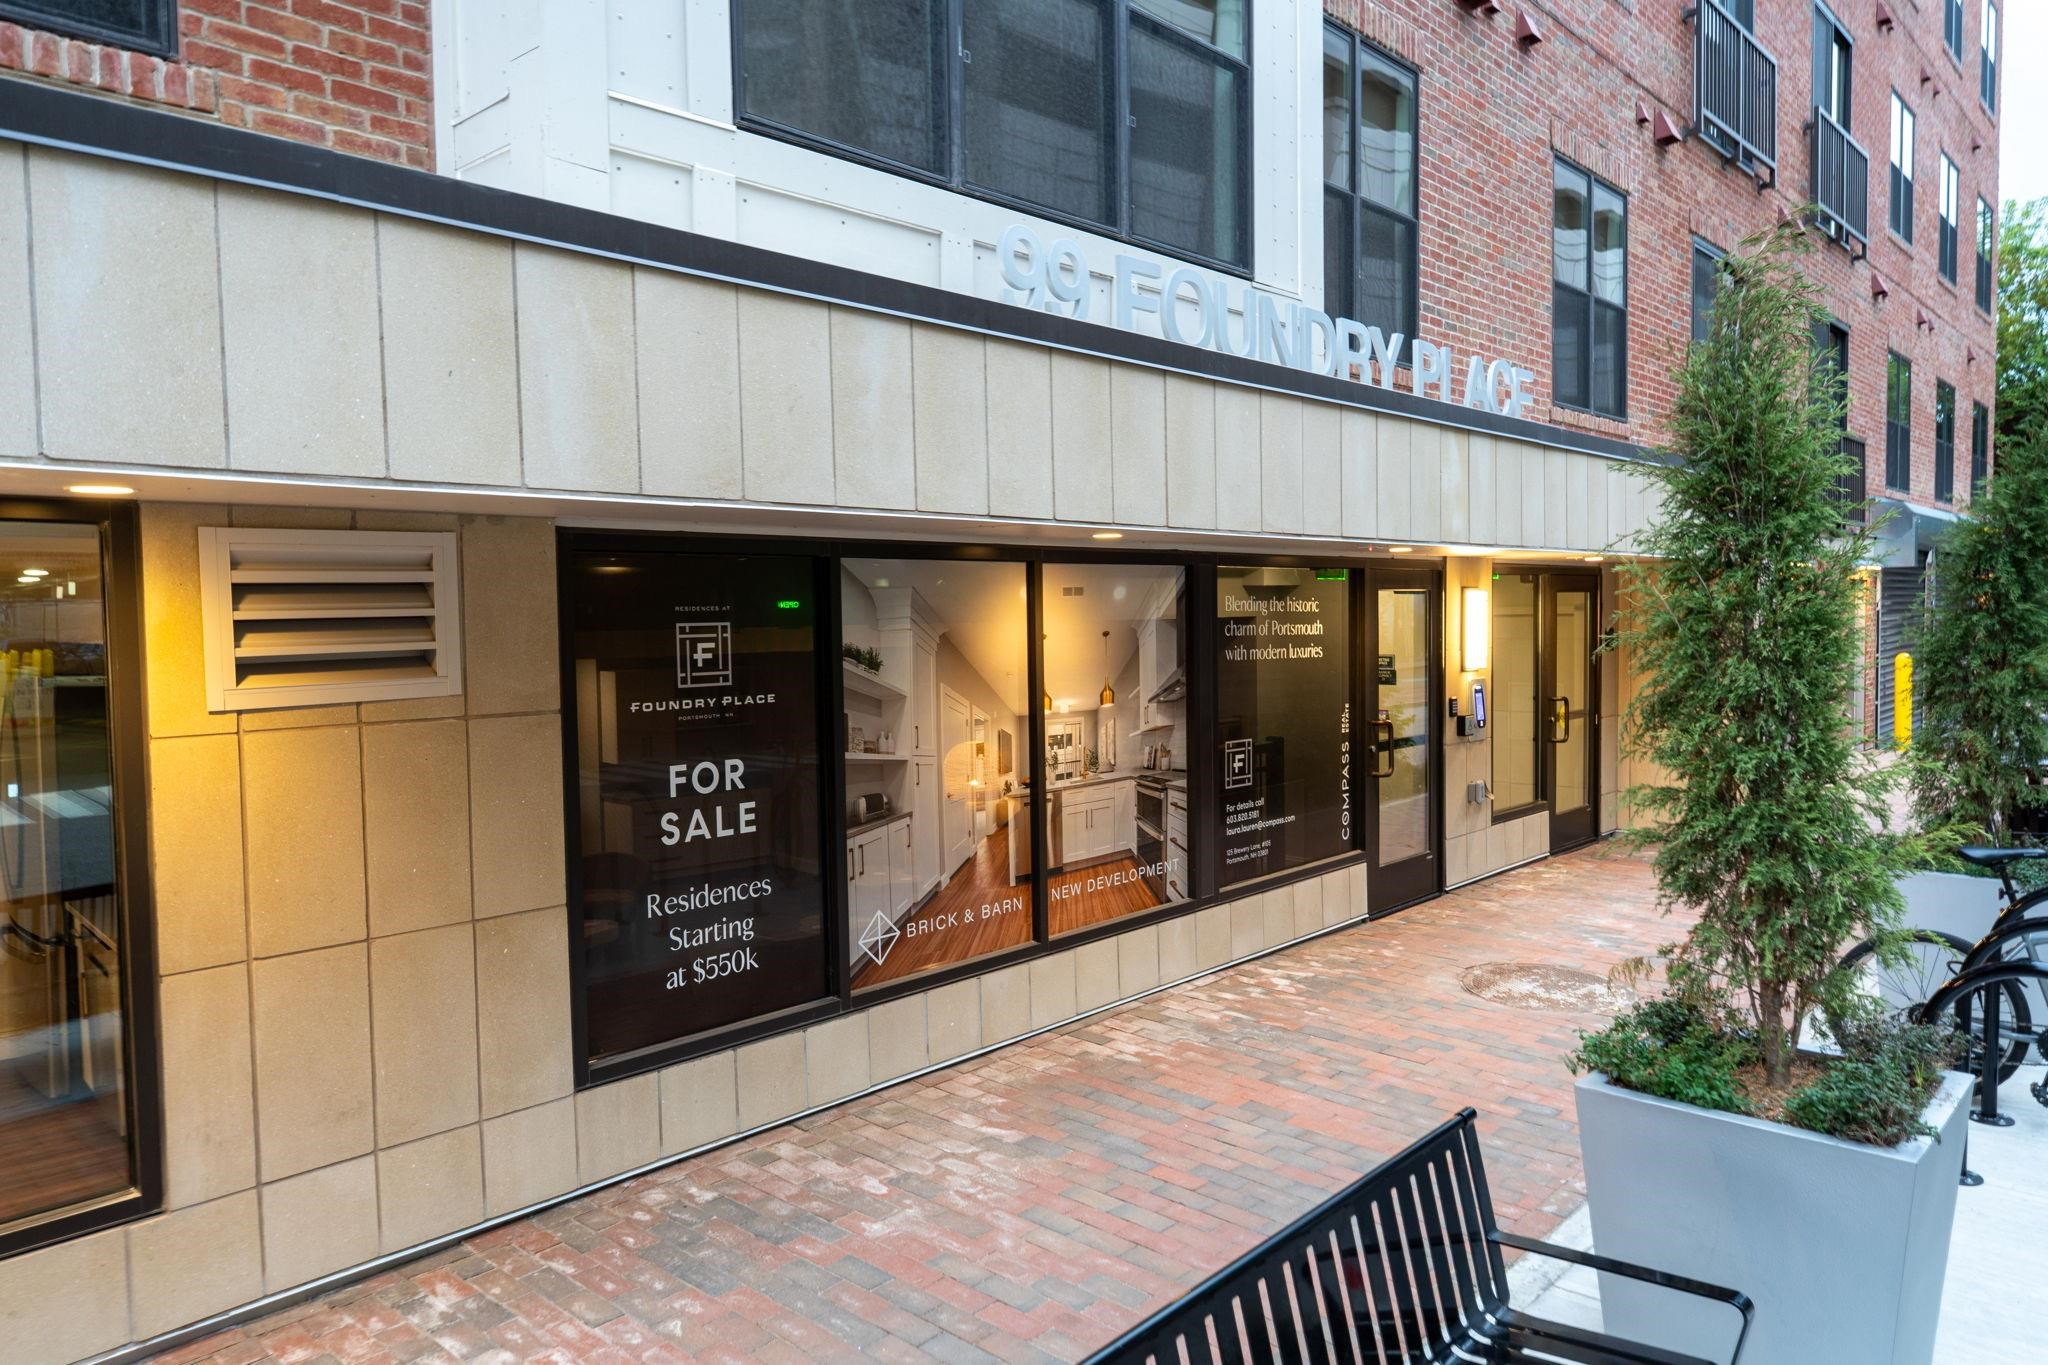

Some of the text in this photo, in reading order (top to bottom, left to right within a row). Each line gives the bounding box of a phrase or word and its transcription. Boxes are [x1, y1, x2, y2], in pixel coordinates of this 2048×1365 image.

[999, 224, 1535, 417] 99 FOUNDRY PLACE
[1225, 595, 1320, 615] Blending the historic
[1224, 620, 1323, 637] charm of Portsmouth
[1225, 643, 1323, 660] with modern luxuries
[630, 694, 776, 713] FOUNDRY PLACE
[678, 713, 721, 721] PORTSMOUTH
[669, 758, 745, 798] FOR
[1341, 741, 1350, 840] COMPASS
[660, 801, 757, 846] SALE
[1226, 797, 1265, 812] For details call
[647, 877, 772, 919] Residences
[1051, 858, 1180, 902] NEW DEVELOPMENT
[669, 917, 755, 951] Starting
[906, 896, 1024, 939] BRICK & BARN
[666, 947, 759, 990] at $550k
